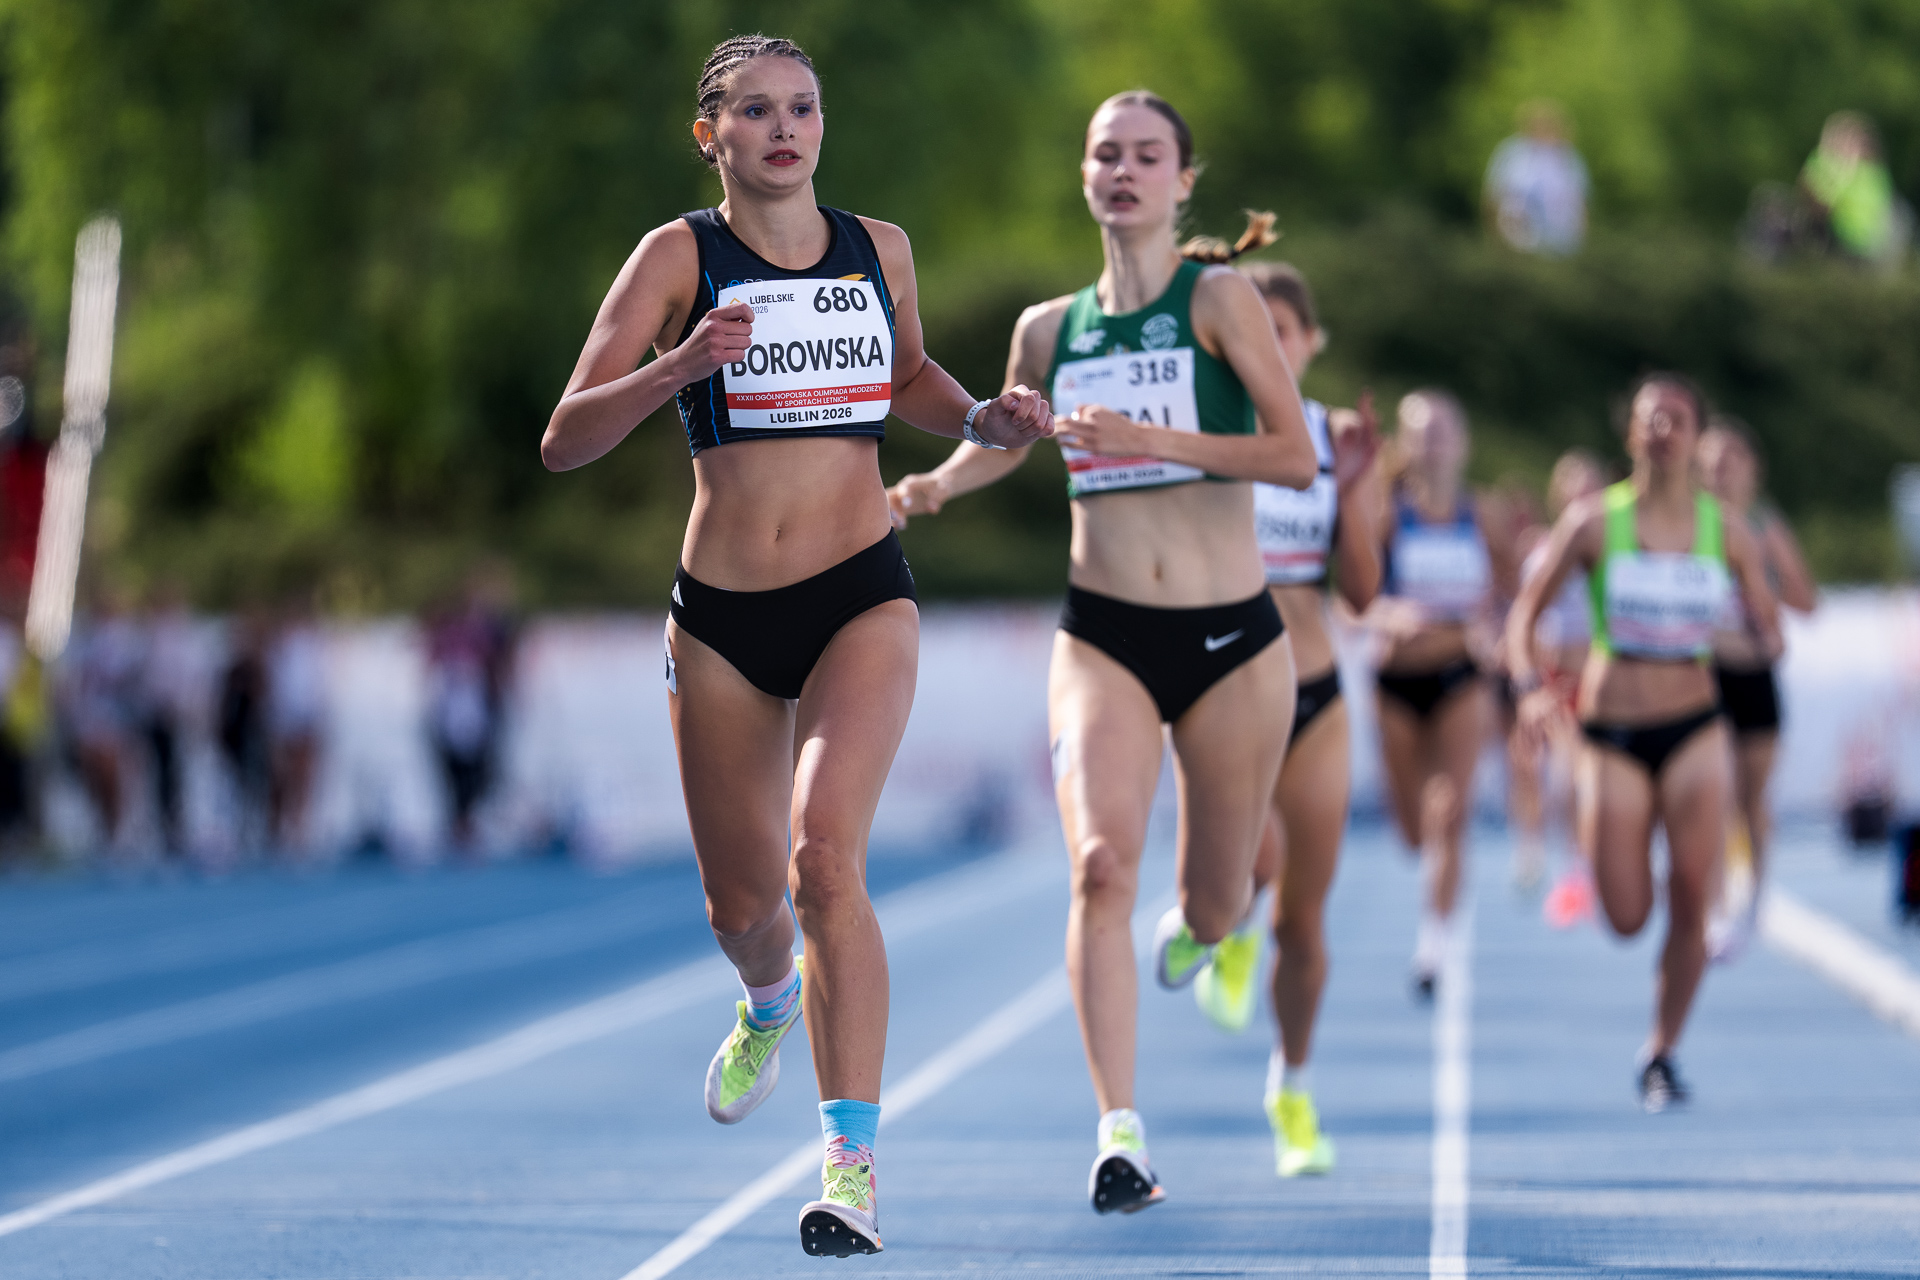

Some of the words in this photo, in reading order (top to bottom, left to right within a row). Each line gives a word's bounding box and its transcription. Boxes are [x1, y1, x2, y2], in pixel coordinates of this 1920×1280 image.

[749, 293, 795, 304] LUBELSKIE
[813, 286, 868, 314] 680
[1128, 358, 1179, 387] 318
[736, 394, 754, 402] XXXII
[754, 390, 812, 401] OGÓLNOPOLSKA
[813, 387, 848, 397] OLIMPIADA
[848, 383, 883, 395] MŁODZIEŻY
[775, 400, 783, 408] W
[784, 398, 822, 407] SPORTACH
[823, 395, 849, 404] LETNICH
[770, 410, 819, 424] LUBLIN
[822, 407, 852, 420] 2026
